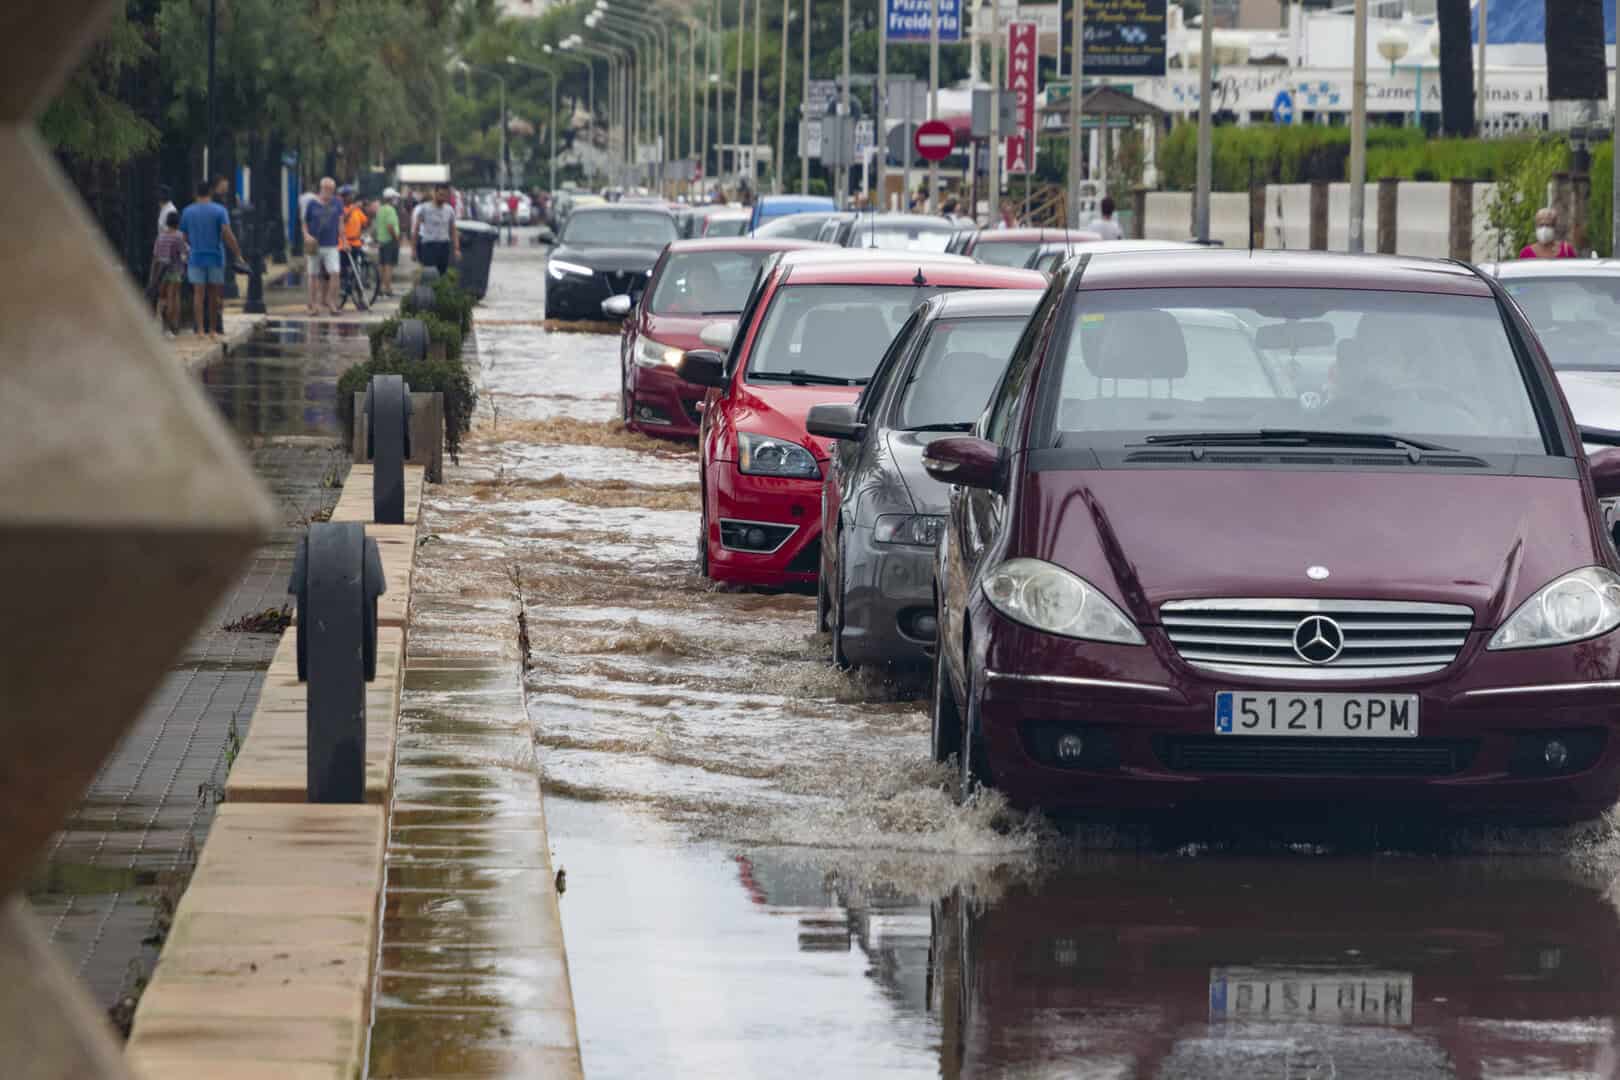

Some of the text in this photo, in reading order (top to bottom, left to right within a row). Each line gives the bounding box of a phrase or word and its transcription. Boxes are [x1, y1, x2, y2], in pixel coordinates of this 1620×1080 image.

[1366, 84, 1417, 100] Carne
[1240, 697, 1324, 730] 5121
[1343, 698, 1410, 731] GPM
